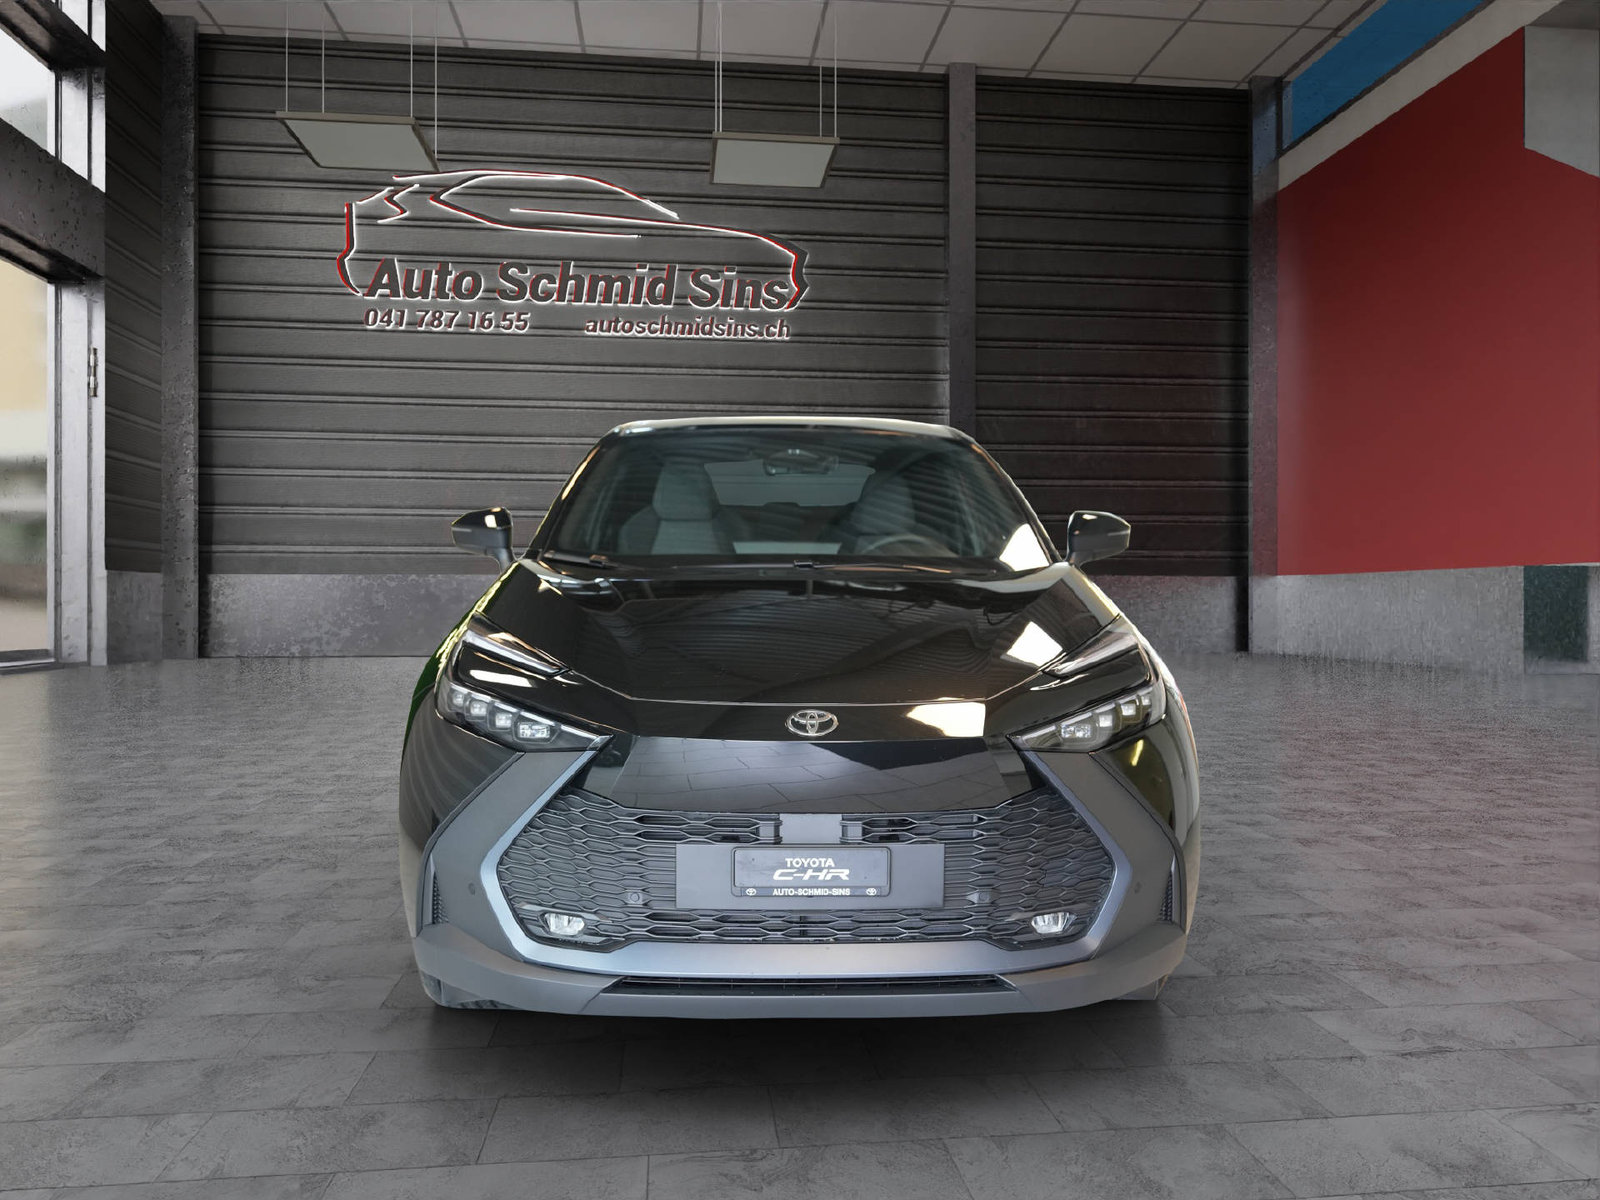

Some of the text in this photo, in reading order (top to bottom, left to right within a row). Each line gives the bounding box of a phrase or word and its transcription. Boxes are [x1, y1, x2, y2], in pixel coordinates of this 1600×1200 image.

[364, 257, 790, 311] Auto Schmid Sins
[364, 308, 531, 333] 041 787 16 55
[585, 314, 791, 340] autoschmidsins.ch
[785, 857, 835, 868] TOYOTA
[773, 869, 850, 881] C-HR
[772, 888, 851, 896] AUTO-SCHMID-SINS
